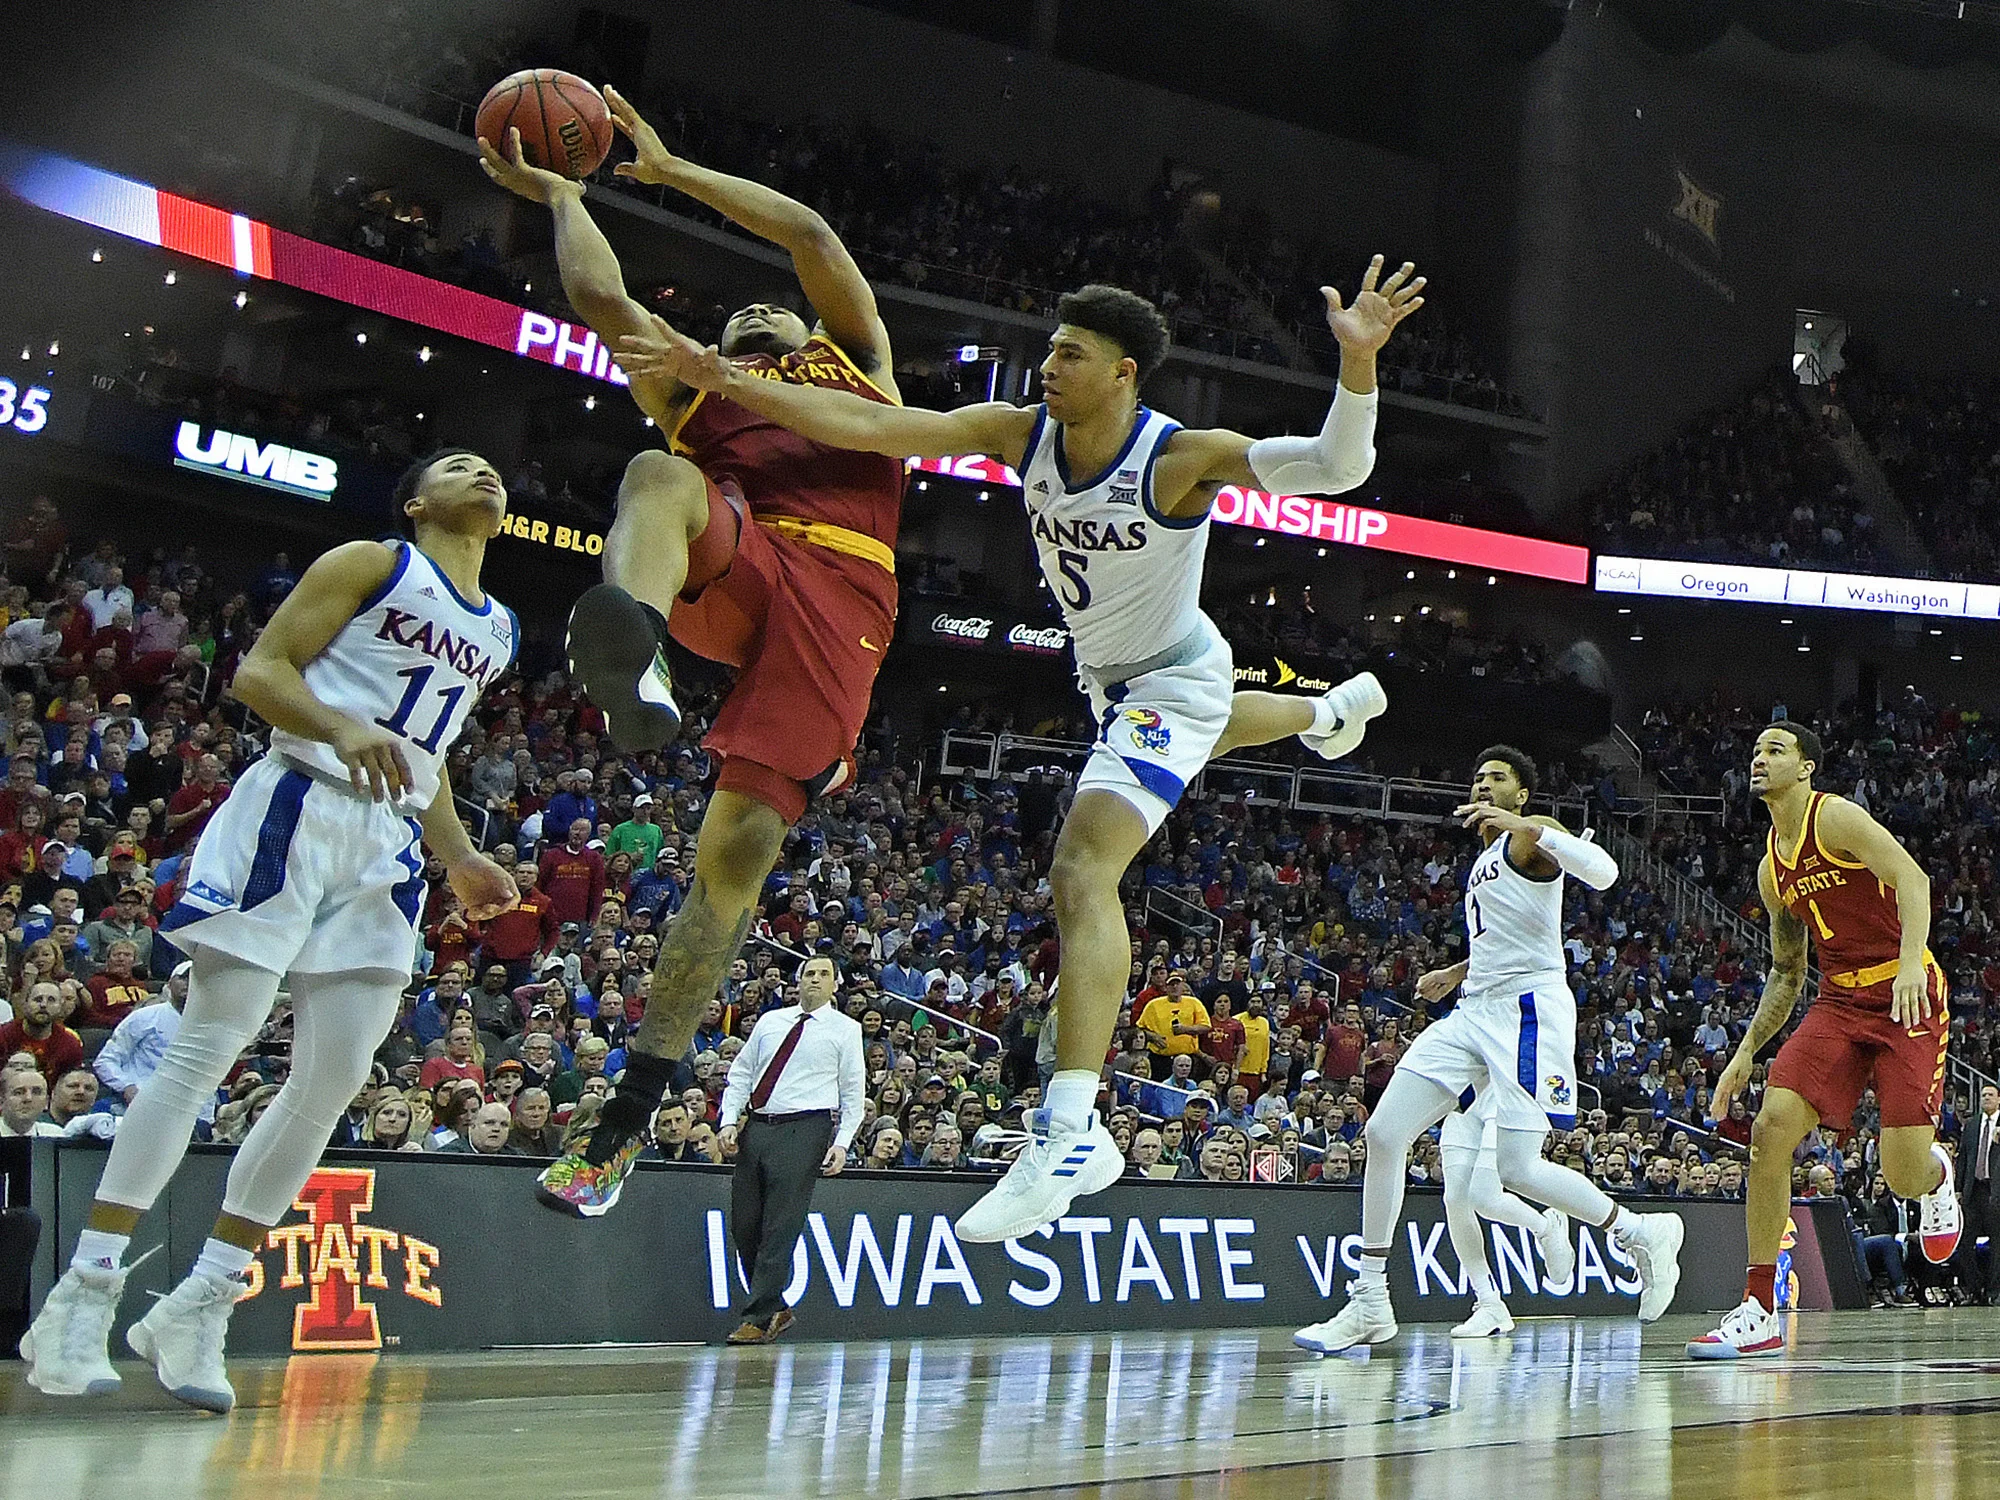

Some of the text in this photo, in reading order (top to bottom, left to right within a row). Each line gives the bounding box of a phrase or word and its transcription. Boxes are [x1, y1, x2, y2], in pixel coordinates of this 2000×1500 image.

[175, 420, 338, 492] UMB
[499, 513, 549, 544] H&R
[1058, 550, 1092, 610] 5
[1598, 569, 1949, 611] NCAA Oregon Washington
[1297, 677, 1331, 690] Center
[374, 664, 468, 756] 11
[1797, 869, 1848, 896] STATE
[1471, 892, 1487, 939] 1
[1808, 899, 1835, 940] 1
[1003, 1215, 1266, 1307] STATE
[1407, 1220, 1644, 1297] KNAS
